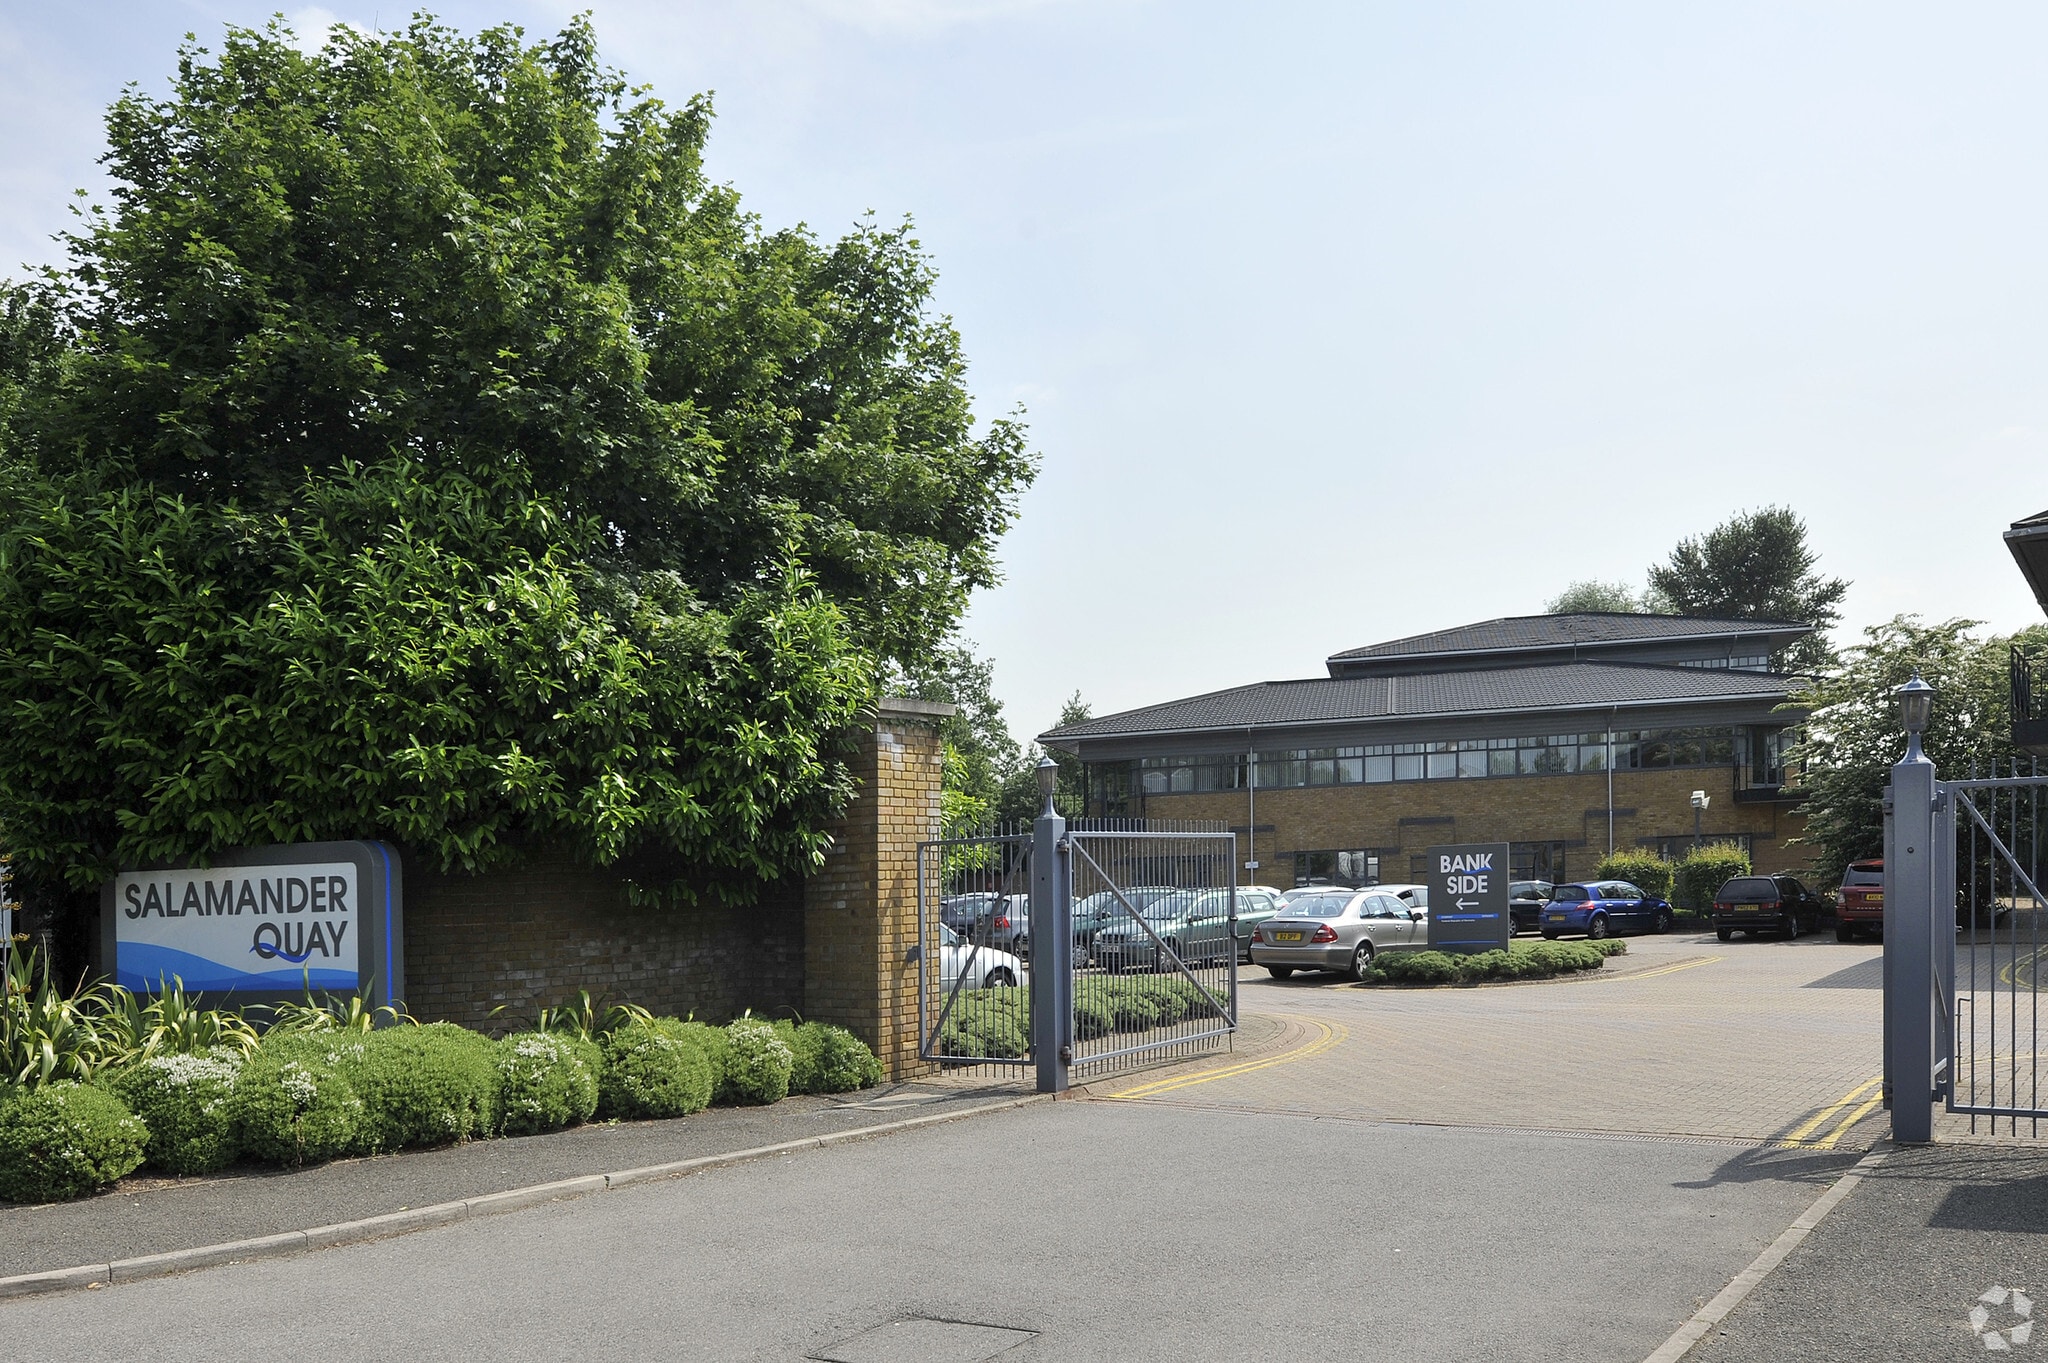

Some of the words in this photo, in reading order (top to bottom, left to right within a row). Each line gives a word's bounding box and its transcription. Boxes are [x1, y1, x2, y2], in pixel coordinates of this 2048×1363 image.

[1440, 853, 1493, 874] BANK
[124, 875, 348, 920] SALAMANDER
[1446, 875, 1488, 895] SIDE
[249, 920, 348, 963] QUAY
